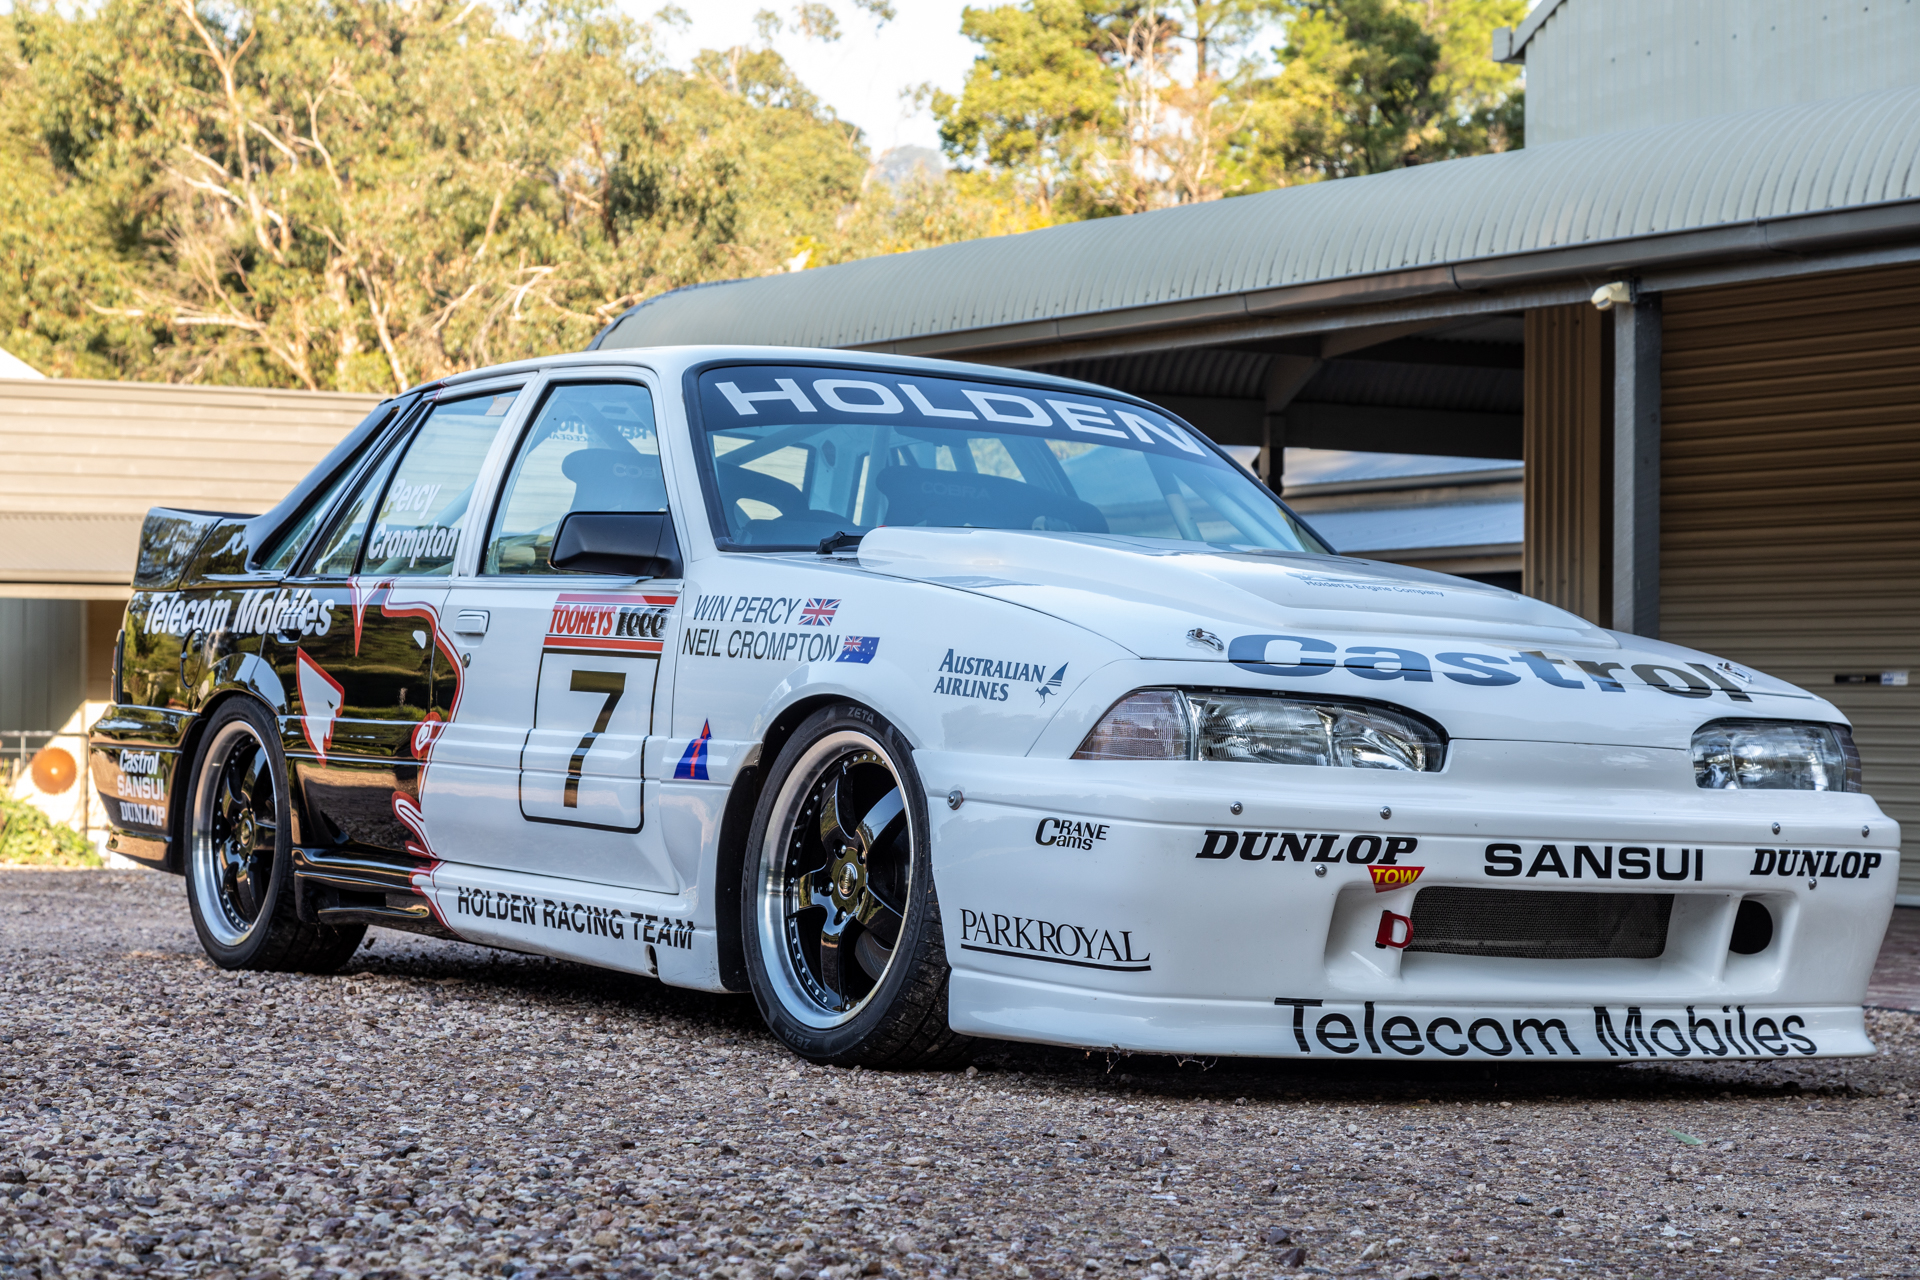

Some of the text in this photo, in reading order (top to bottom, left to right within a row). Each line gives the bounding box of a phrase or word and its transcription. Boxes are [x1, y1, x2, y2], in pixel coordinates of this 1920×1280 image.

[715, 377, 1207, 458] HOLDEN
[383, 478, 442, 520] Percy
[920, 481, 992, 501] COBRA
[367, 522, 458, 567] Crompton
[1354, 583, 1391, 591] Engine
[1392, 586, 1445, 597] Company
[143, 588, 335, 636] Telecom Mobiles
[549, 604, 671, 637] TOOHEYS 1000
[693, 595, 801, 625] WIN PERCY
[681, 628, 840, 662] NEIL CROMPTON
[1227, 634, 1753, 702] Castrol
[933, 676, 1010, 702] AIRLINES
[848, 706, 875, 725] ZETA
[564, 670, 627, 808] 7
[119, 749, 160, 774] Castrol
[117, 775, 165, 800] SANSUI
[119, 801, 165, 826] DUNLOP
[1035, 817, 1110, 845] CRANE
[1195, 830, 1882, 882] DUNLOP SANSUI DUNLOP
[1373, 869, 1419, 884] TOW
[457, 886, 697, 950] HOLDEN RACING TEAM
[960, 909, 1151, 962] PARKROYAL
[1275, 998, 1817, 1057] Telecom Mobiles
